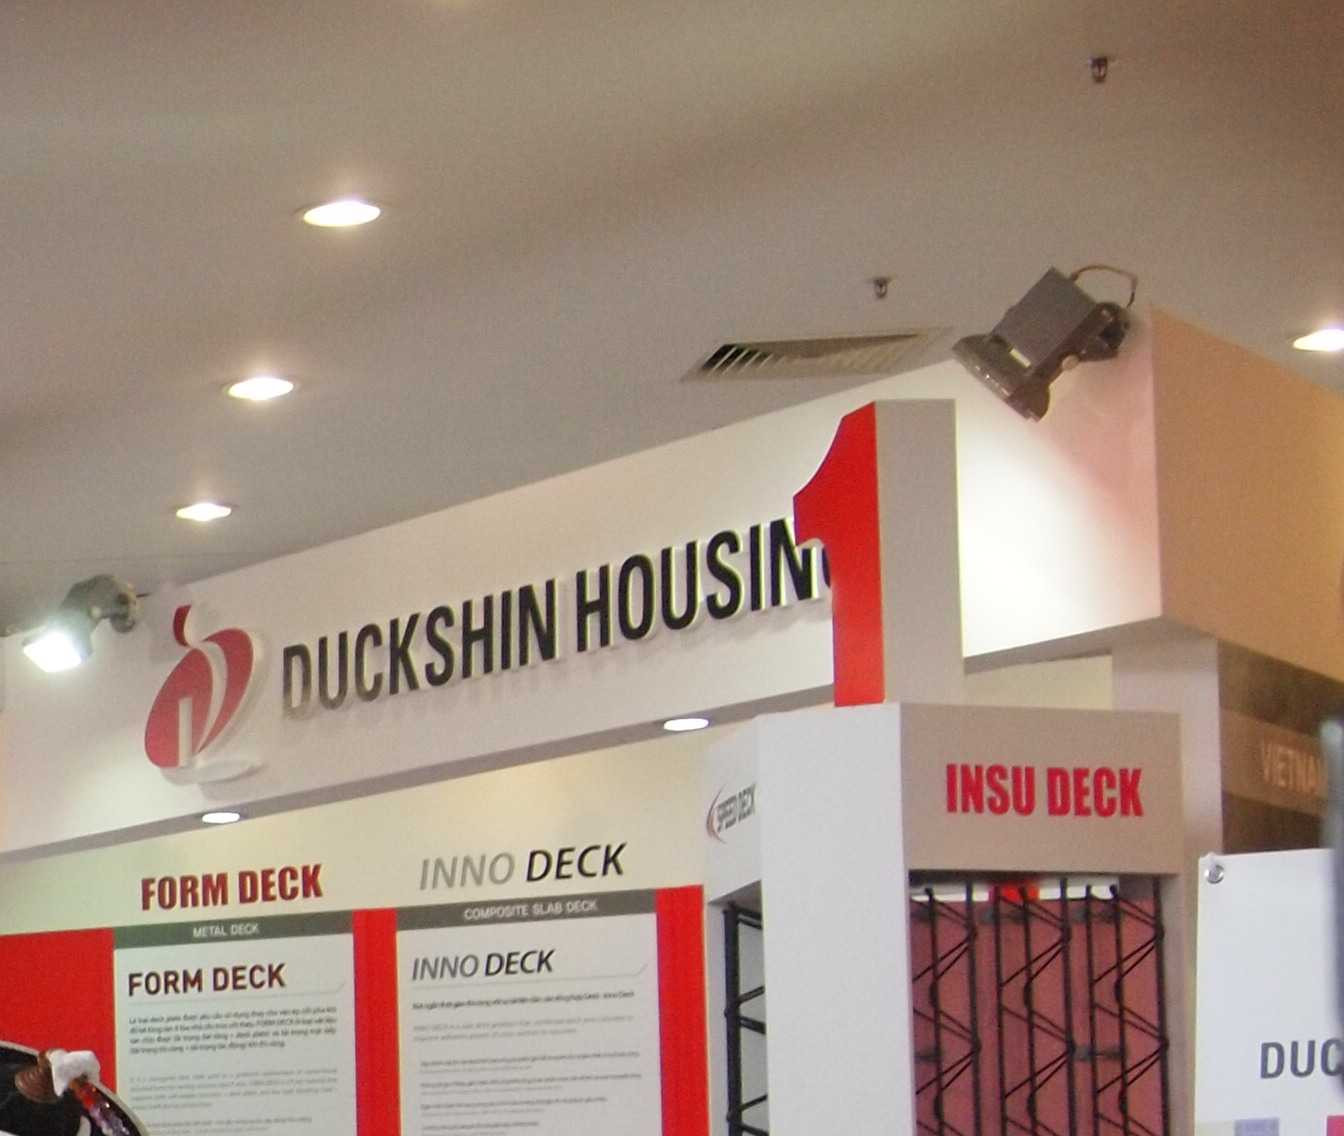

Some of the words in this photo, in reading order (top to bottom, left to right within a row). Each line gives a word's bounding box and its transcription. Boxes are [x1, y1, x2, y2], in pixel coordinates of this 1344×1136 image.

[282, 577, 558, 719] DUCKSHIN
[574, 516, 832, 654] HOUSIN
[945, 763, 1036, 816] INSU
[1047, 766, 1144, 818] DECK
[419, 852, 517, 891] INNO
[525, 842, 628, 883] DECK
[141, 872, 229, 911] FORM
[238, 864, 323, 905] DECK
[464, 903, 529, 921] COMPOSITE
[532, 902, 563, 917] SLAB
[565, 899, 599, 915] DECK
[193, 925, 228, 939] METAL
[230, 922, 259, 936] DECK
[128, 967, 203, 997] FORM
[212, 963, 286, 992] DECK
[412, 953, 480, 982] INNO
[484, 949, 556, 977] DECK
